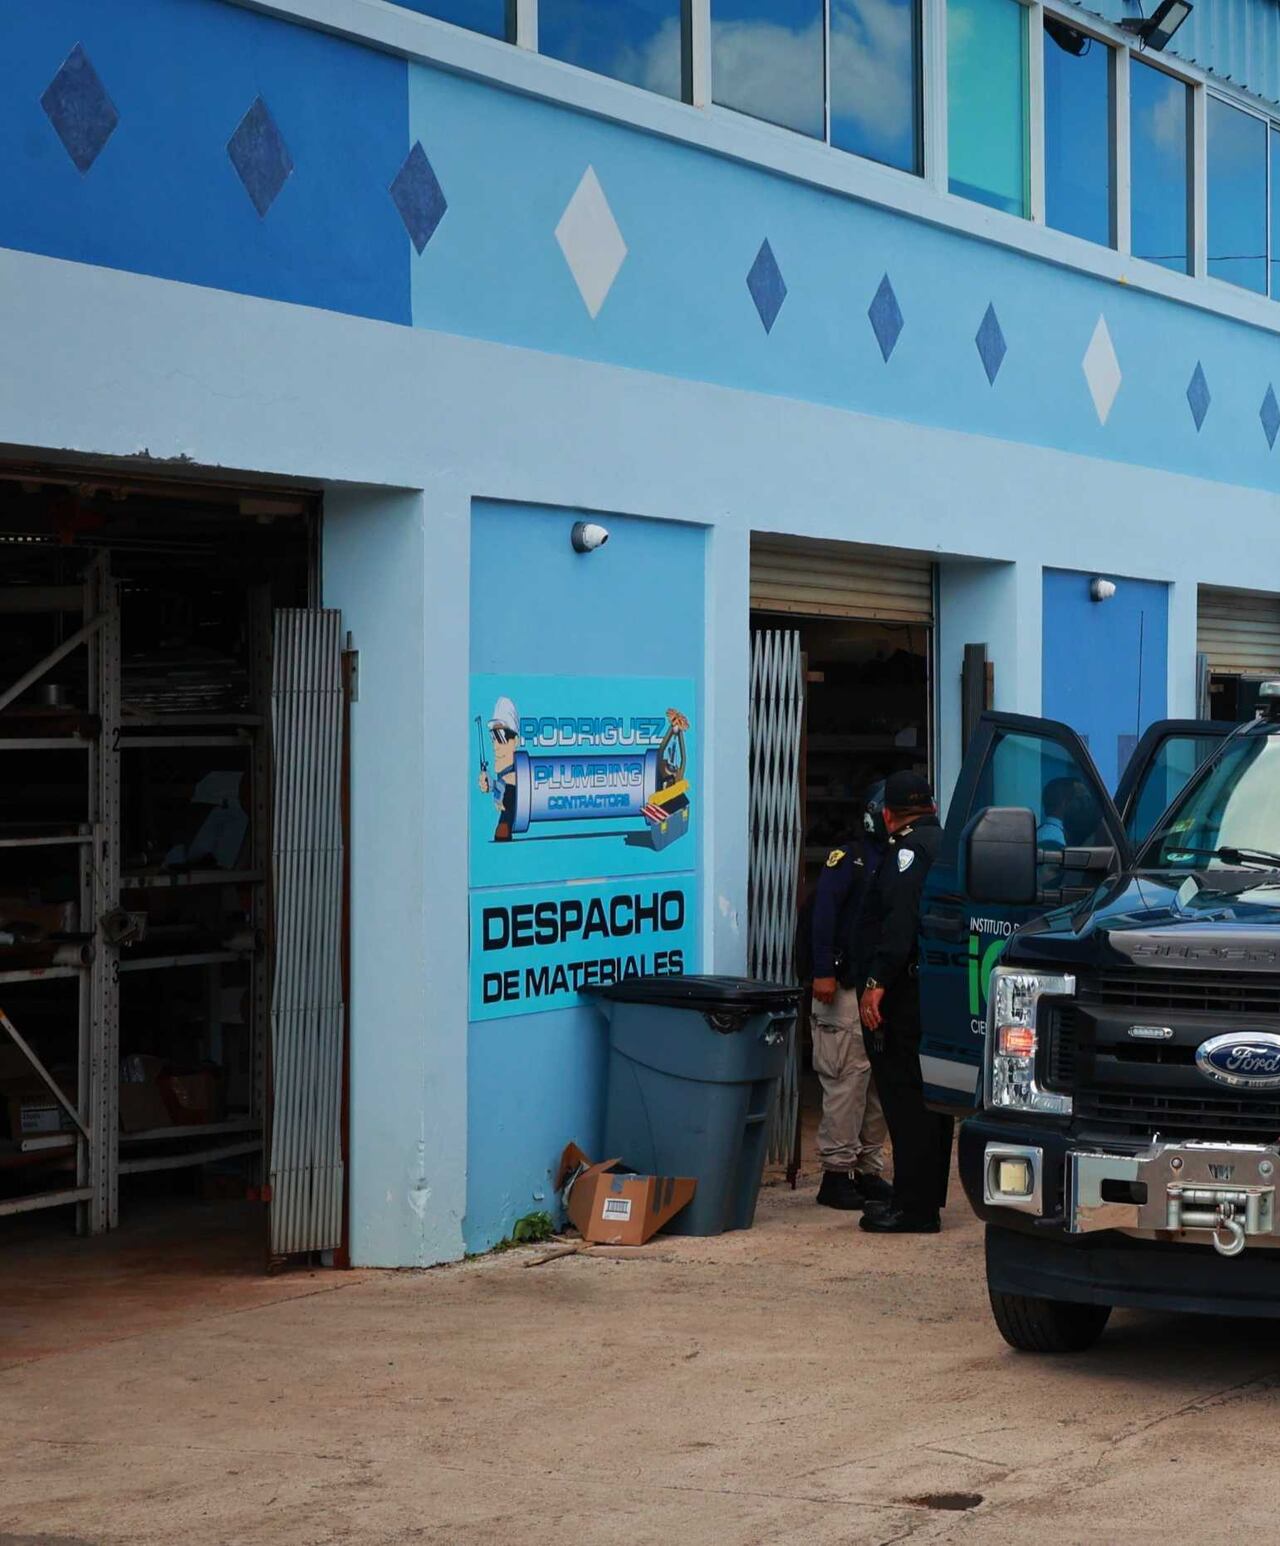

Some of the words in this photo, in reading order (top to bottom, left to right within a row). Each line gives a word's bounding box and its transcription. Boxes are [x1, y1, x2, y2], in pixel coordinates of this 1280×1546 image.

[112, 727, 121, 752] 2
[520, 717, 666, 747] RODRIGUEZ
[533, 763, 642, 790] PLUMBING
[547, 794, 630, 810] CONTRACTORS
[483, 890, 685, 951] DESPACHO
[970, 917, 1012, 936] INSTITUTO
[112, 959, 120, 984] 3
[483, 970, 520, 1003] DE
[526, 950, 684, 998] MATERIALES
